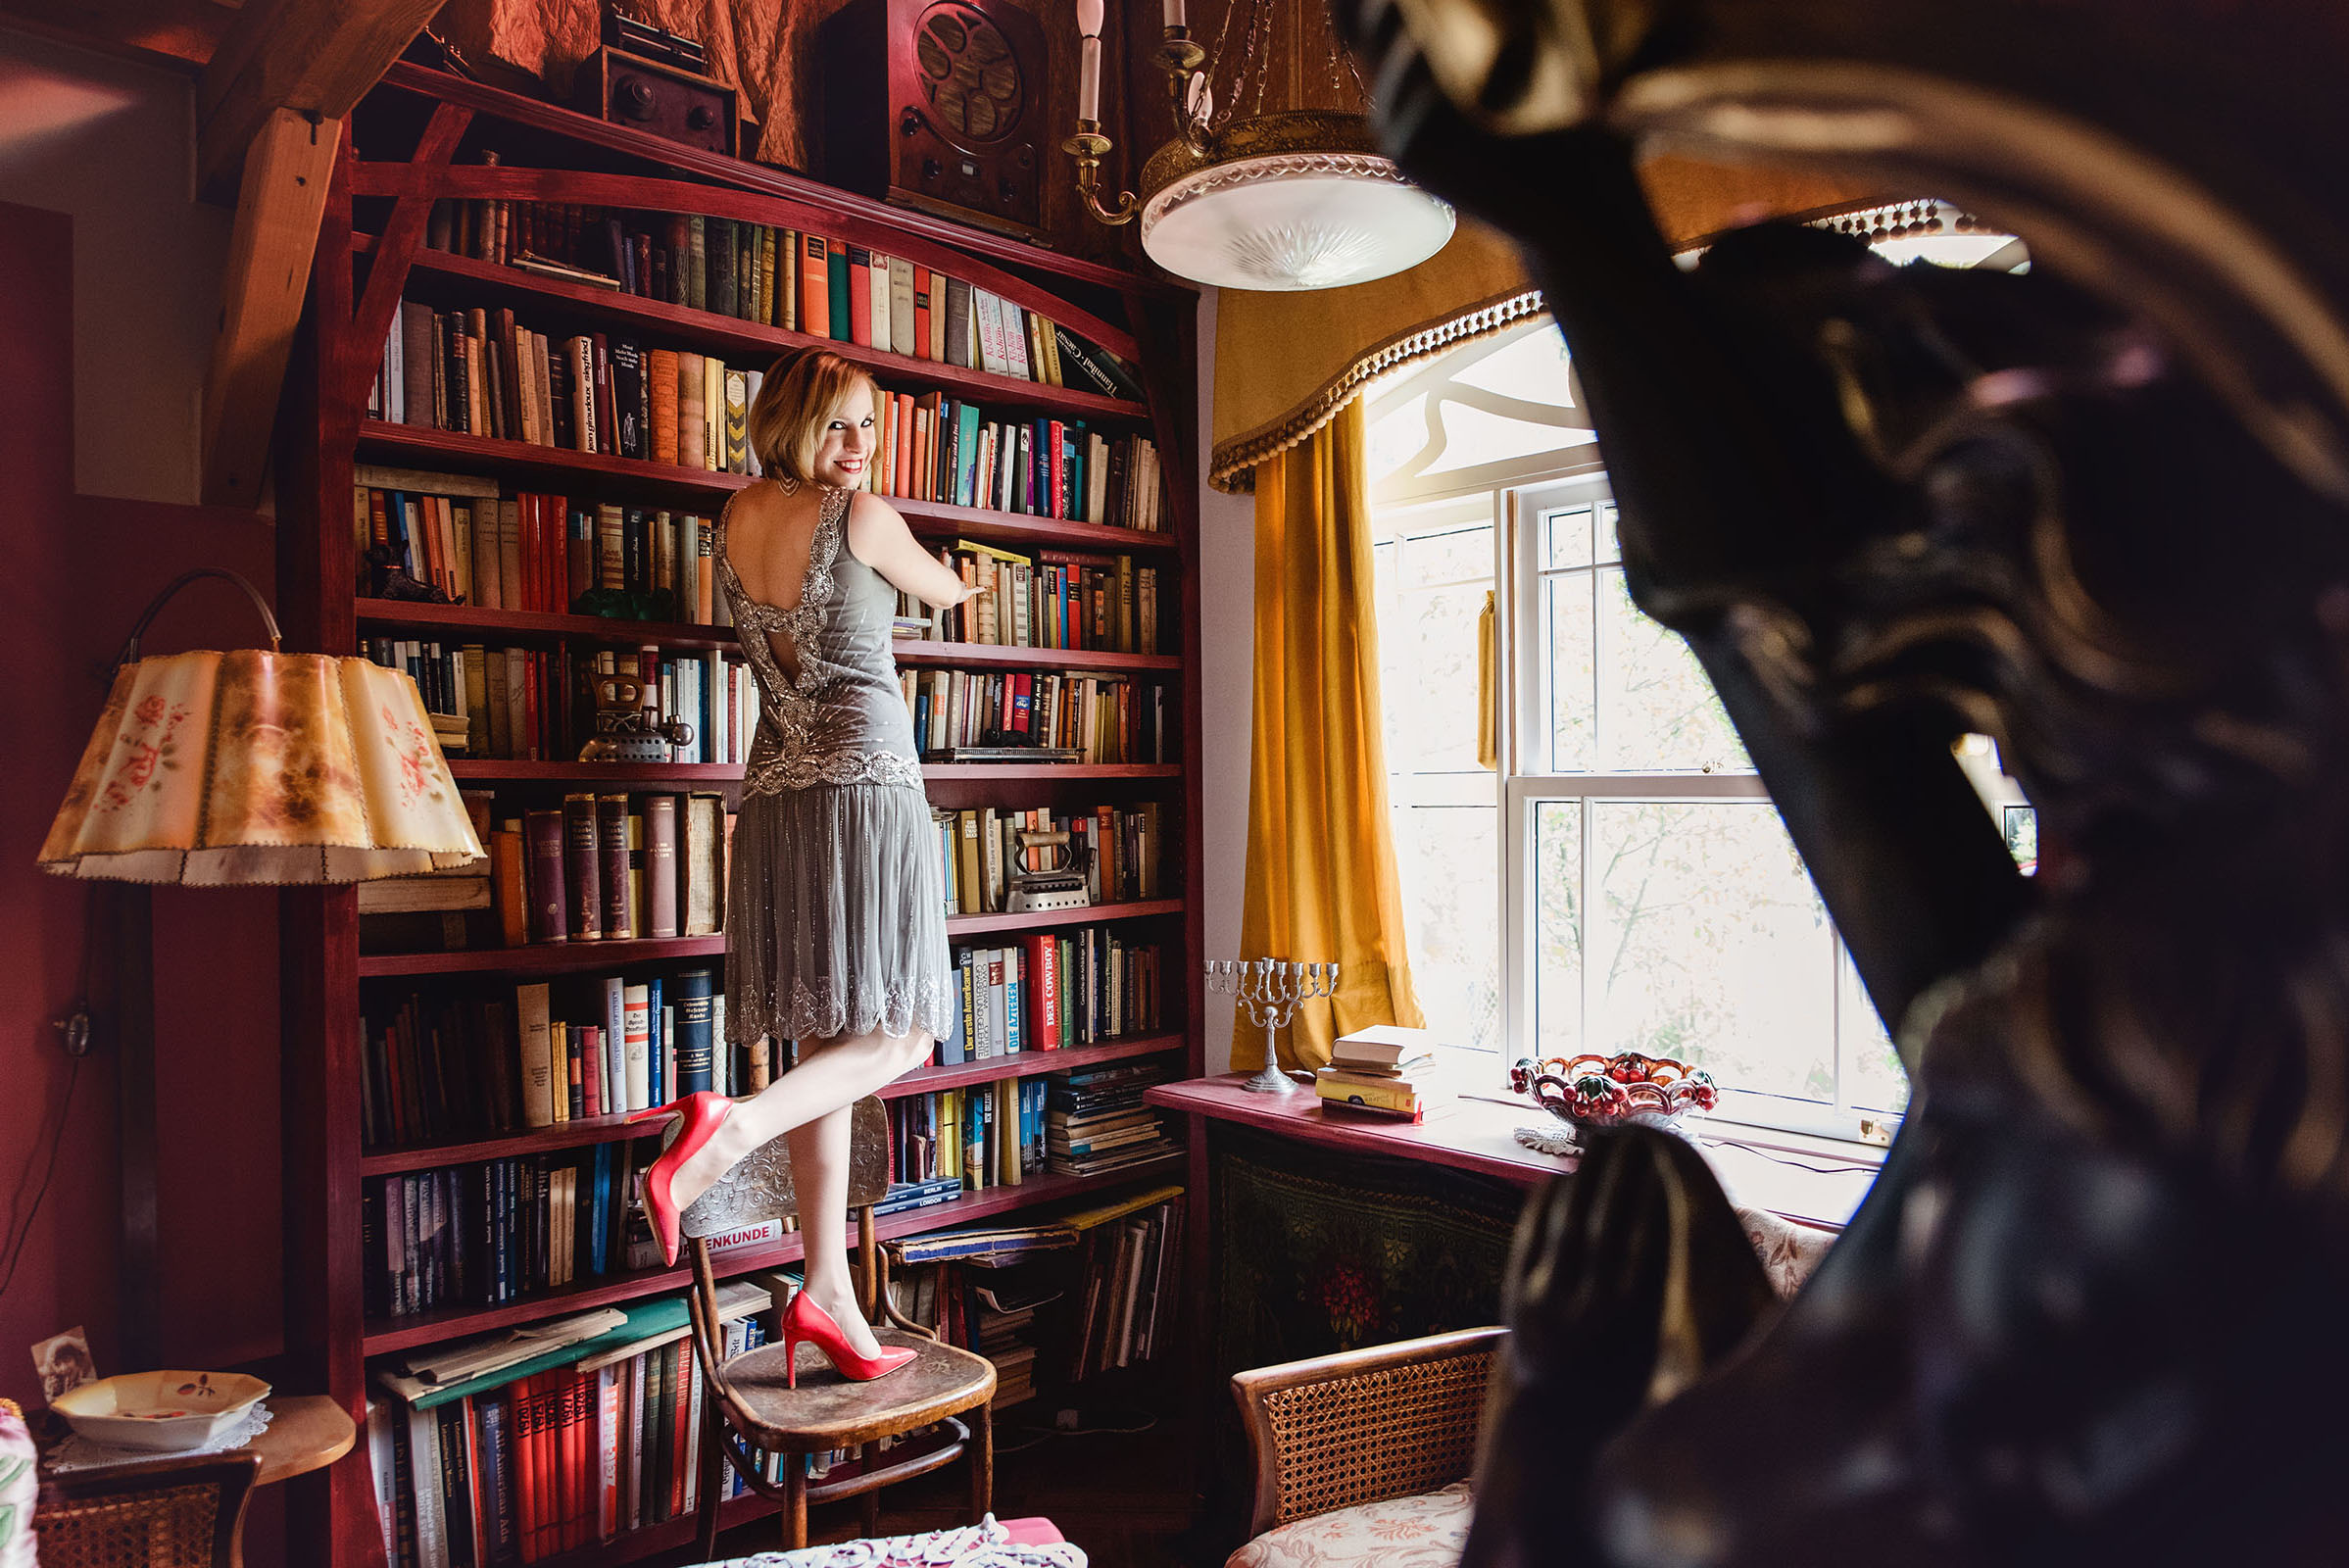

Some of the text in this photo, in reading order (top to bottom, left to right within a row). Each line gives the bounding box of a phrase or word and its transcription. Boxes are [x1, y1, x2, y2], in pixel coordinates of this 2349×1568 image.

[581, 339, 590, 382] siegfried
[1055, 330, 1118, 394] Hannibal Caesar
[585, 386, 594, 432] giraudoux
[962, 966, 974, 1051] Der erste Amerikaner
[1044, 946, 1054, 1027] DER COWBOY
[1007, 982, 1019, 1048] DIE AZTEKEN
[919, 1198, 942, 1207] LONDON
[923, 1186, 942, 1195] BERLIN
[706, 1226, 770, 1250] ENKUNDE
[517, 1408, 530, 1434] 1920
[494, 1429, 509, 1544] All-American Ads
